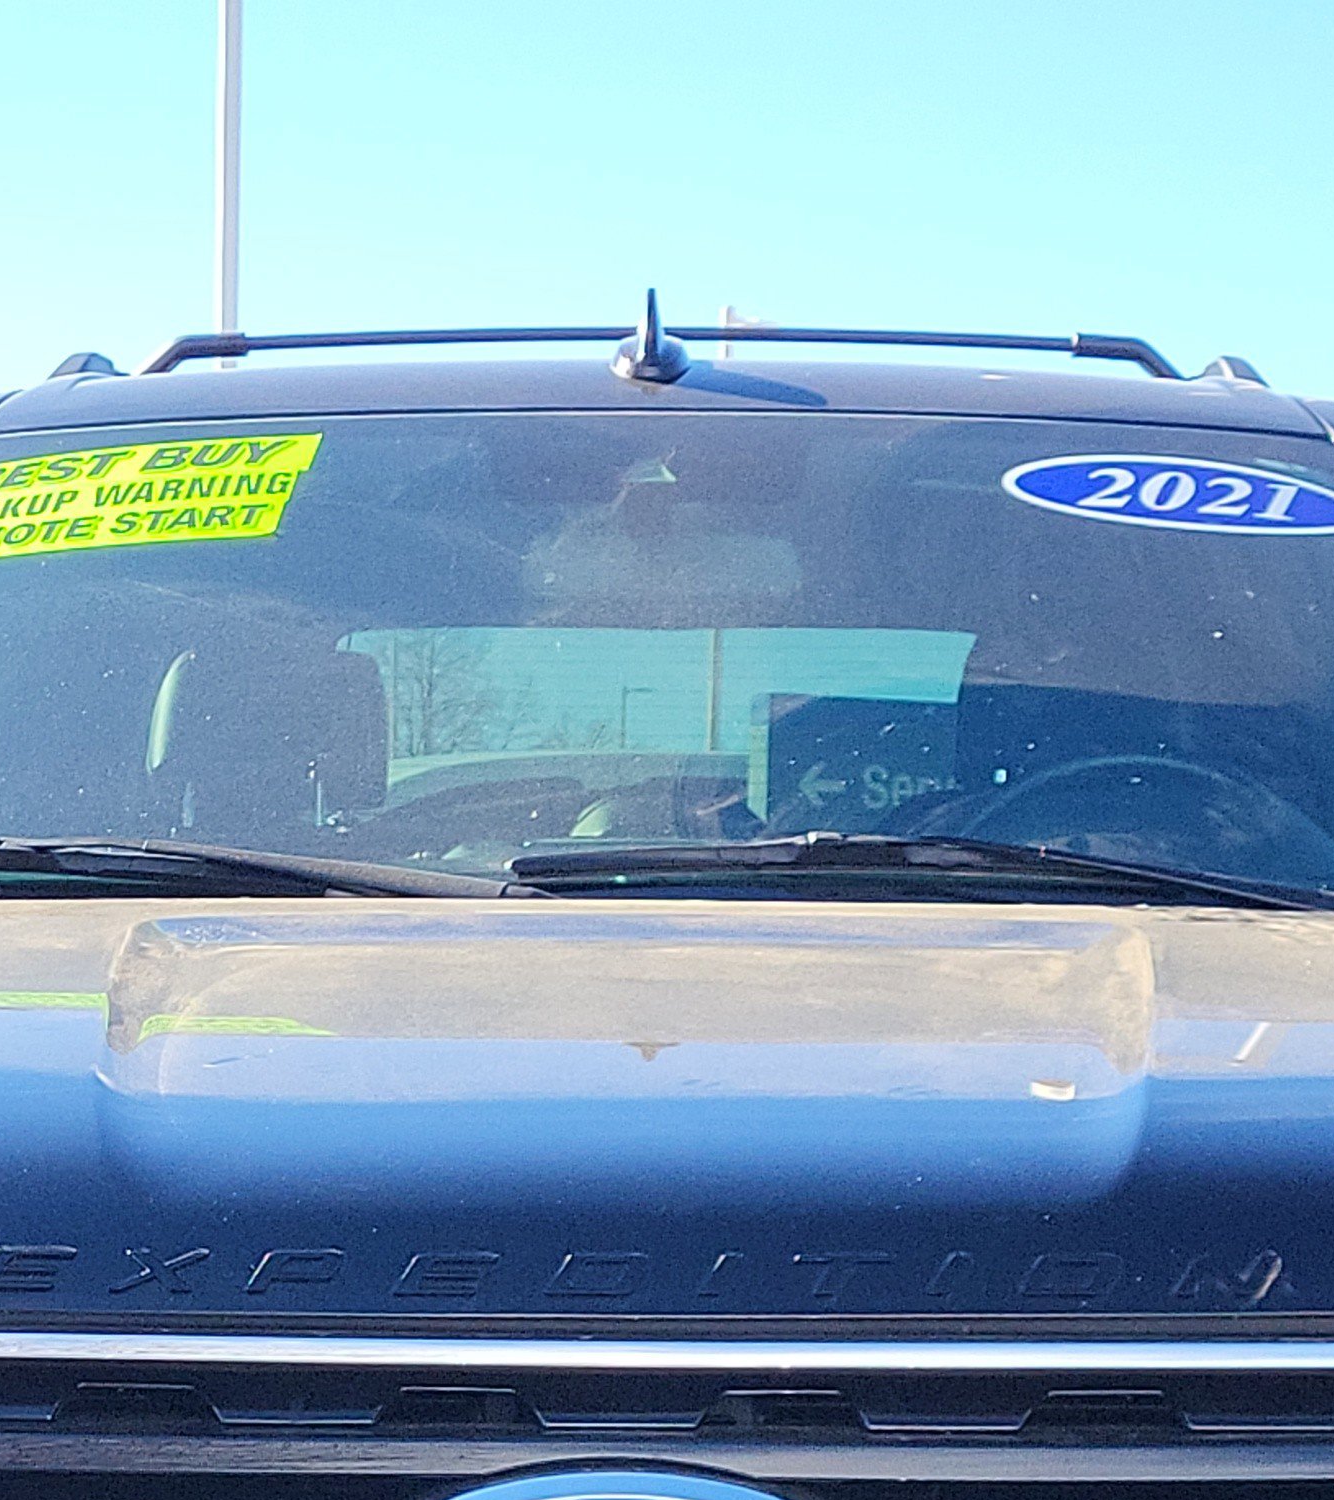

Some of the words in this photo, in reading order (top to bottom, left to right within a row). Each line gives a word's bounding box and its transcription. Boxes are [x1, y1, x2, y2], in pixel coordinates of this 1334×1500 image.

[139, 439, 295, 473] BUY
[94, 472, 292, 508] WARNING
[1075, 467, 1301, 522] 2021
[109, 503, 274, 535] START
